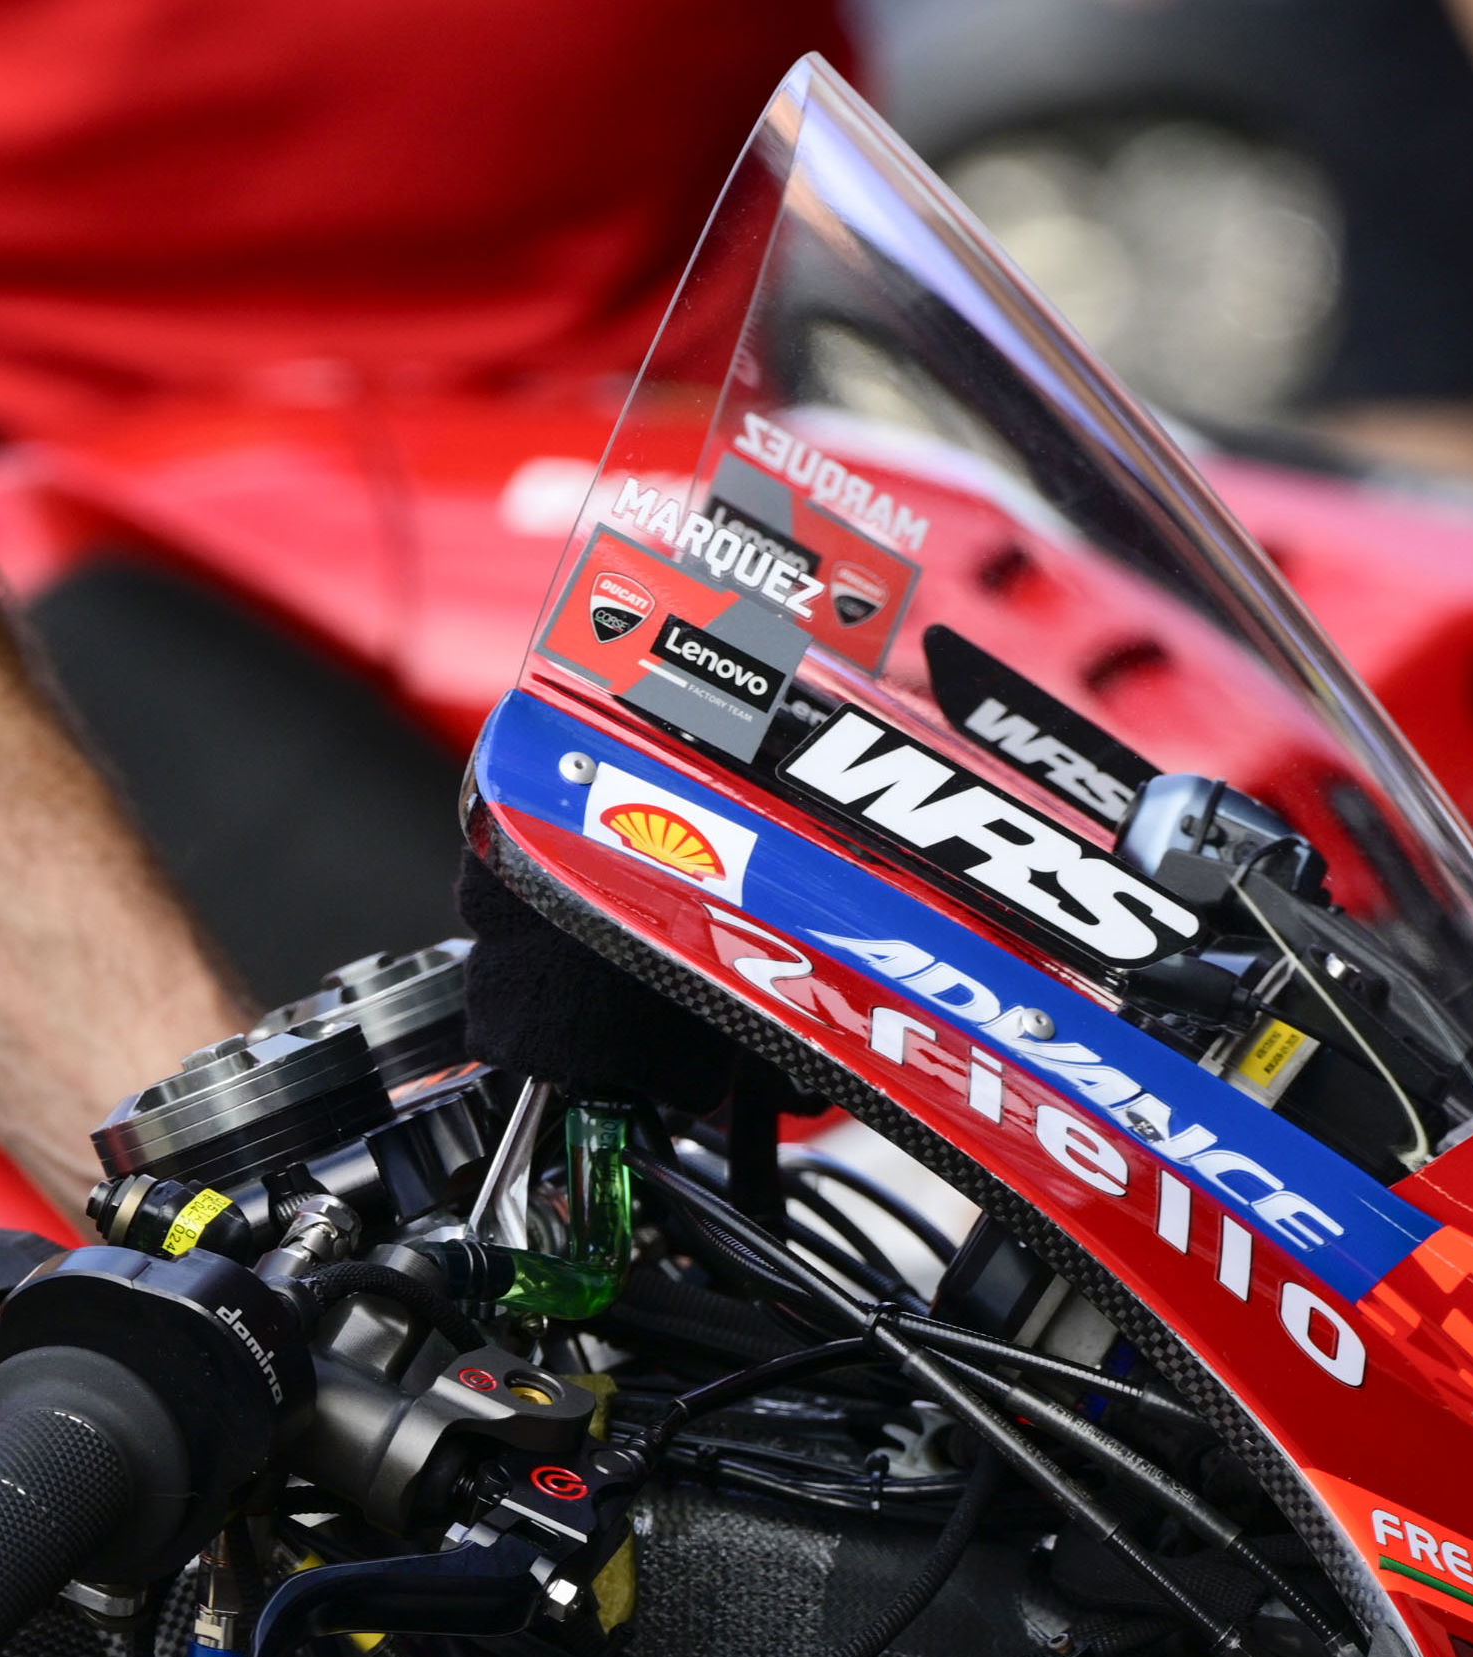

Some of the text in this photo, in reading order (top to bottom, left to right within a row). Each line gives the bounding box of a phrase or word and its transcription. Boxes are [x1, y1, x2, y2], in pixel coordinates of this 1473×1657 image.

[600, 579, 649, 610] DUCATI
[613, 477, 825, 619] MARQUEZ
[595, 608, 629, 632] CORSE
[663, 626, 769, 696] Lenovo
[687, 683, 754, 723] FACTORY TEAM
[964, 698, 1137, 822] WRS
[785, 711, 1200, 961] WRS
[808, 929, 1345, 1252] ADVANCE
[870, 1005, 1368, 1388] riello
[215, 1305, 284, 1406] domino
